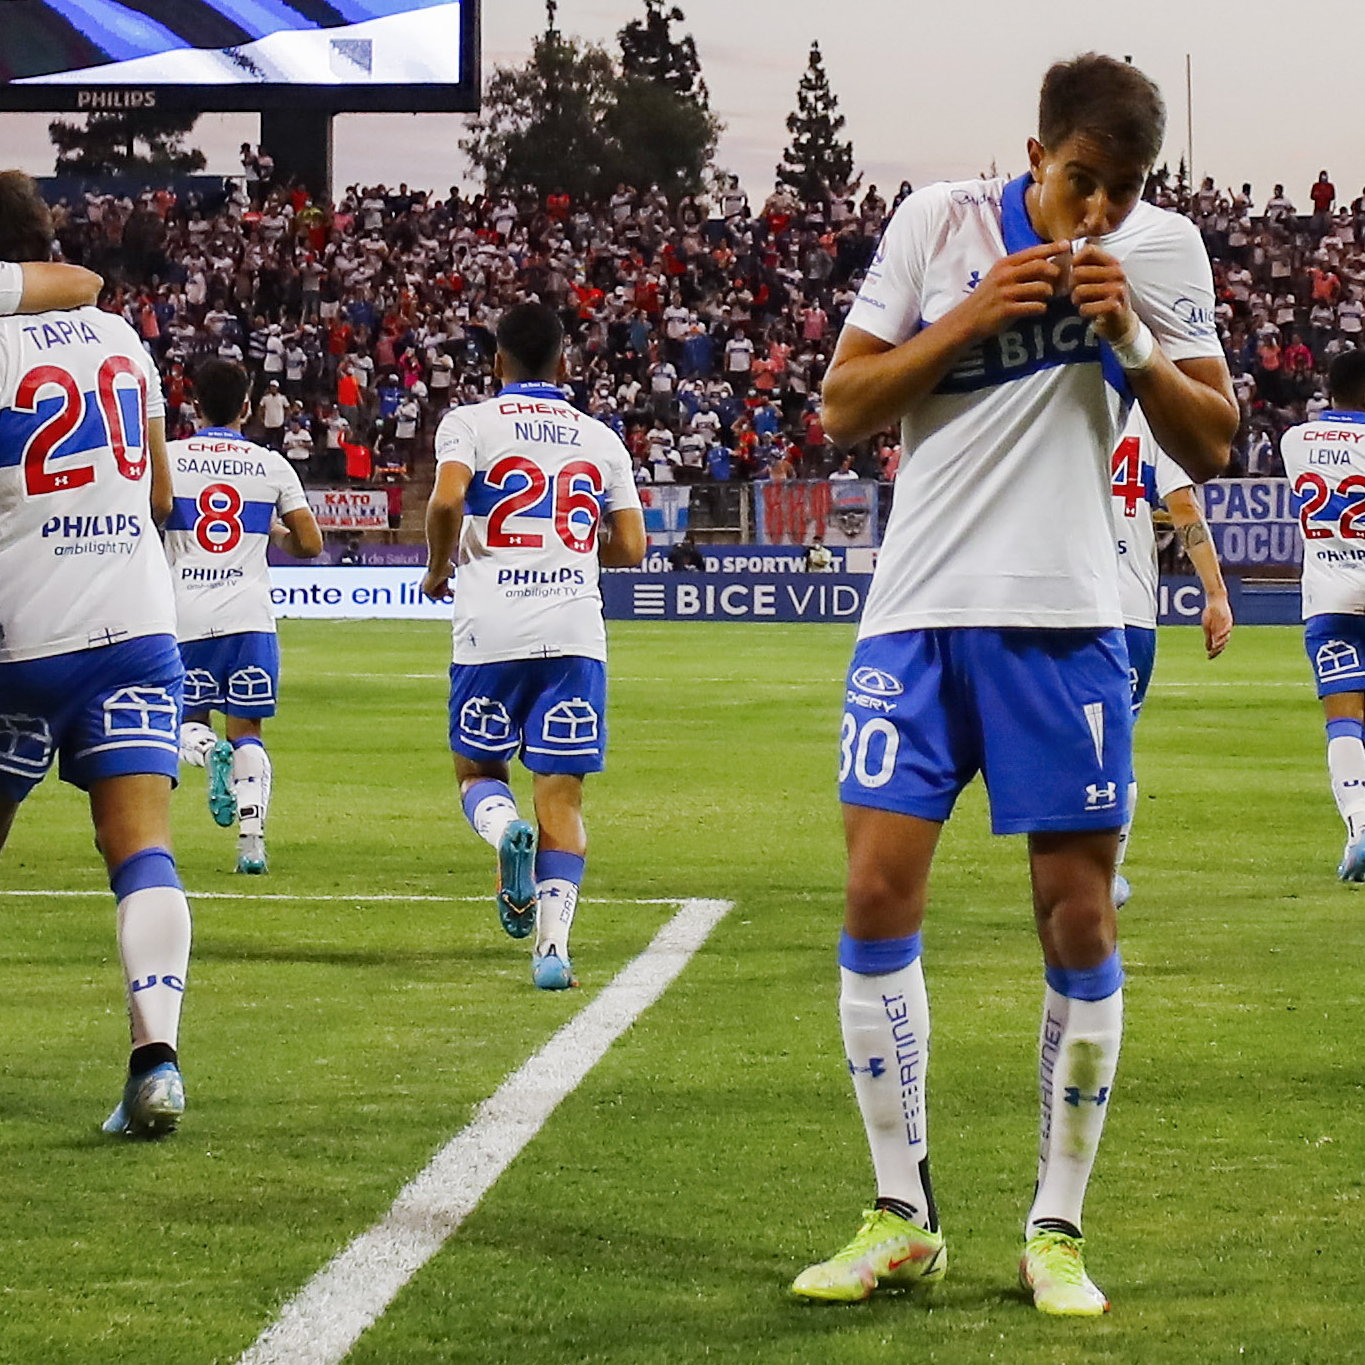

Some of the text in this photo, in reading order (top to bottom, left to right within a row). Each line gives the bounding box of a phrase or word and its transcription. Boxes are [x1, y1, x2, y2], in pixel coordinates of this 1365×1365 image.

[78, 91, 156, 107] PHILIPS
[23, 320, 101, 351] TAPIA
[499, 402, 580, 422] CHERY
[11, 354, 148, 496] 20
[514, 419, 581, 447] NÚÑEZ
[1303, 430, 1365, 443] CHERY
[187, 442, 253, 454] CHERY
[1309, 448, 1351, 466] LEIVA
[176, 458, 267, 478] SAAVEDRA
[325, 494, 371, 505] KATO
[485, 455, 604, 555] 26
[41, 514, 141, 538] PHILIPS
[194, 481, 245, 554] 8
[54, 542, 133, 556] ambilight TV
[386, 553, 420, 565] Salud
[498, 567, 584, 585] PHILIPS
[352, 587, 391, 604] en
[563, 586, 578, 597] TV
[676, 584, 860, 616] BICE VID
[846, 690, 898, 713] CHERY
[838, 712, 901, 789] 30
